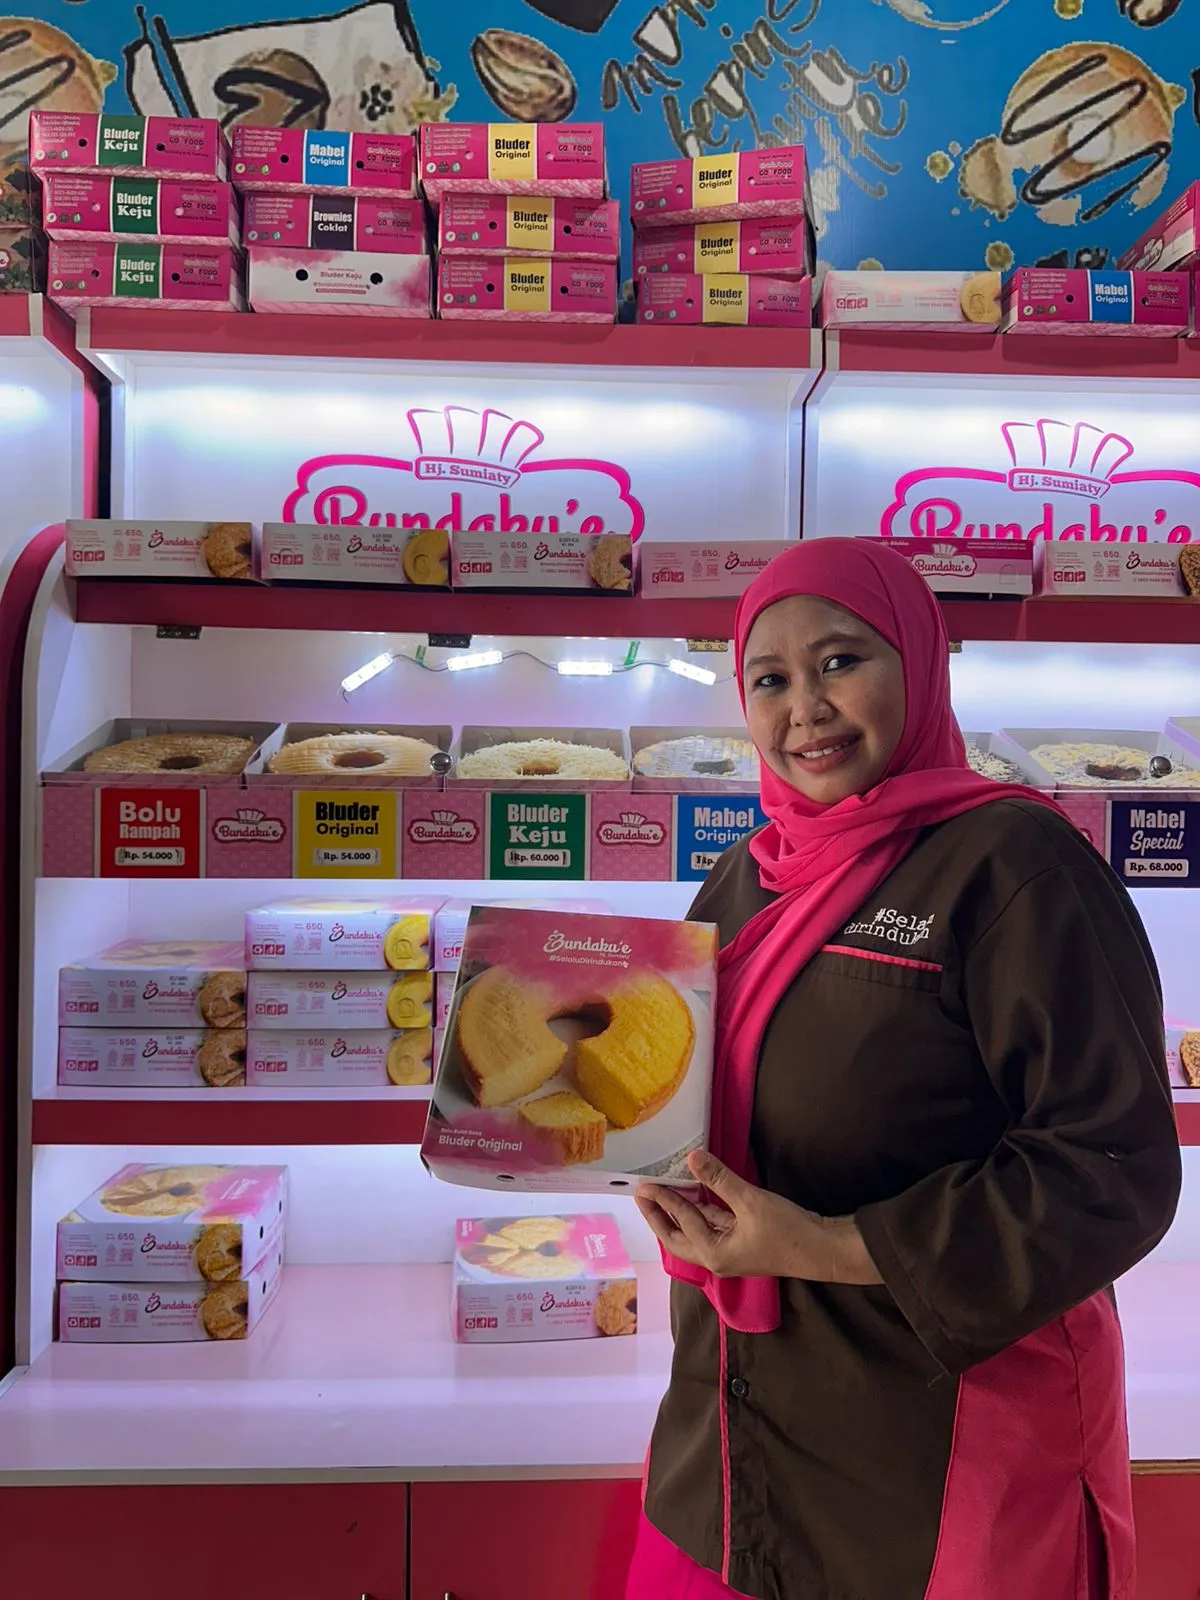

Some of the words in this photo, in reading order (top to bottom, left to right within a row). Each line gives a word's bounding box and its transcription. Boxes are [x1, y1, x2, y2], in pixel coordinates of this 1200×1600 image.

[104, 128, 140, 140] Bluder
[104, 140, 138, 152] Keju
[310, 144, 344, 157] Mabel
[495, 139, 530, 150] Bluder
[495, 150, 530, 159] Original
[310, 156, 344, 167] Original
[699, 169, 732, 181] Bluder
[699, 180, 732, 189] Original
[116, 192, 153, 205] Bluder
[117, 205, 152, 219] Keju
[313, 211, 352, 223] Brownies
[513, 211, 548, 222] Bluder
[317, 223, 348, 233] Coklat
[513, 222, 548, 231] Original
[700, 238, 733, 249] Bluder
[701, 248, 733, 257] Original
[120, 259, 155, 271] Bluder
[120, 271, 154, 284] Keju
[320, 271, 344, 279] Bluder
[345, 272, 362, 281] Keju
[510, 273, 544, 284] Bluder
[511, 284, 545, 294] Original
[709, 289, 742, 299] Bluder
[1095, 284, 1127, 295] Mabel
[710, 299, 742, 307] Original
[1095, 295, 1128, 304] Original
[424, 463, 446, 476] Hj.
[449, 465, 511, 486] Sumiaty
[1018, 475, 1039, 487] Hj.
[1042, 476, 1101, 496] Sumiaty
[915, 559, 972, 573] Bundaku'e
[120, 800, 180, 822] Bolu
[316, 802, 380, 820] Bluder
[508, 804, 569, 823] Bluder
[694, 807, 754, 828] Mabel
[1130, 809, 1185, 828] Mabel
[120, 824, 180, 840] Rampah
[219, 826, 280, 838] Bundaku'e
[316, 823, 378, 838] Original
[414, 826, 472, 838] Bundaku'e
[509, 825, 566, 847] Keju
[602, 829, 660, 841] Bundaku'e
[695, 829, 746, 844] Origin
[1130, 830, 1184, 856] Special
[124, 851, 140, 860] Rp.
[341, 852, 370, 860] 54.000
[531, 854, 559, 862] 60.000
[1130, 863, 1147, 872] Rp.
[1149, 863, 1182, 871] 68.000
[543, 930, 632, 953] Bundaku'e
[439, 1135, 476, 1146] Bluder
[477, 1139, 522, 1151] Original
